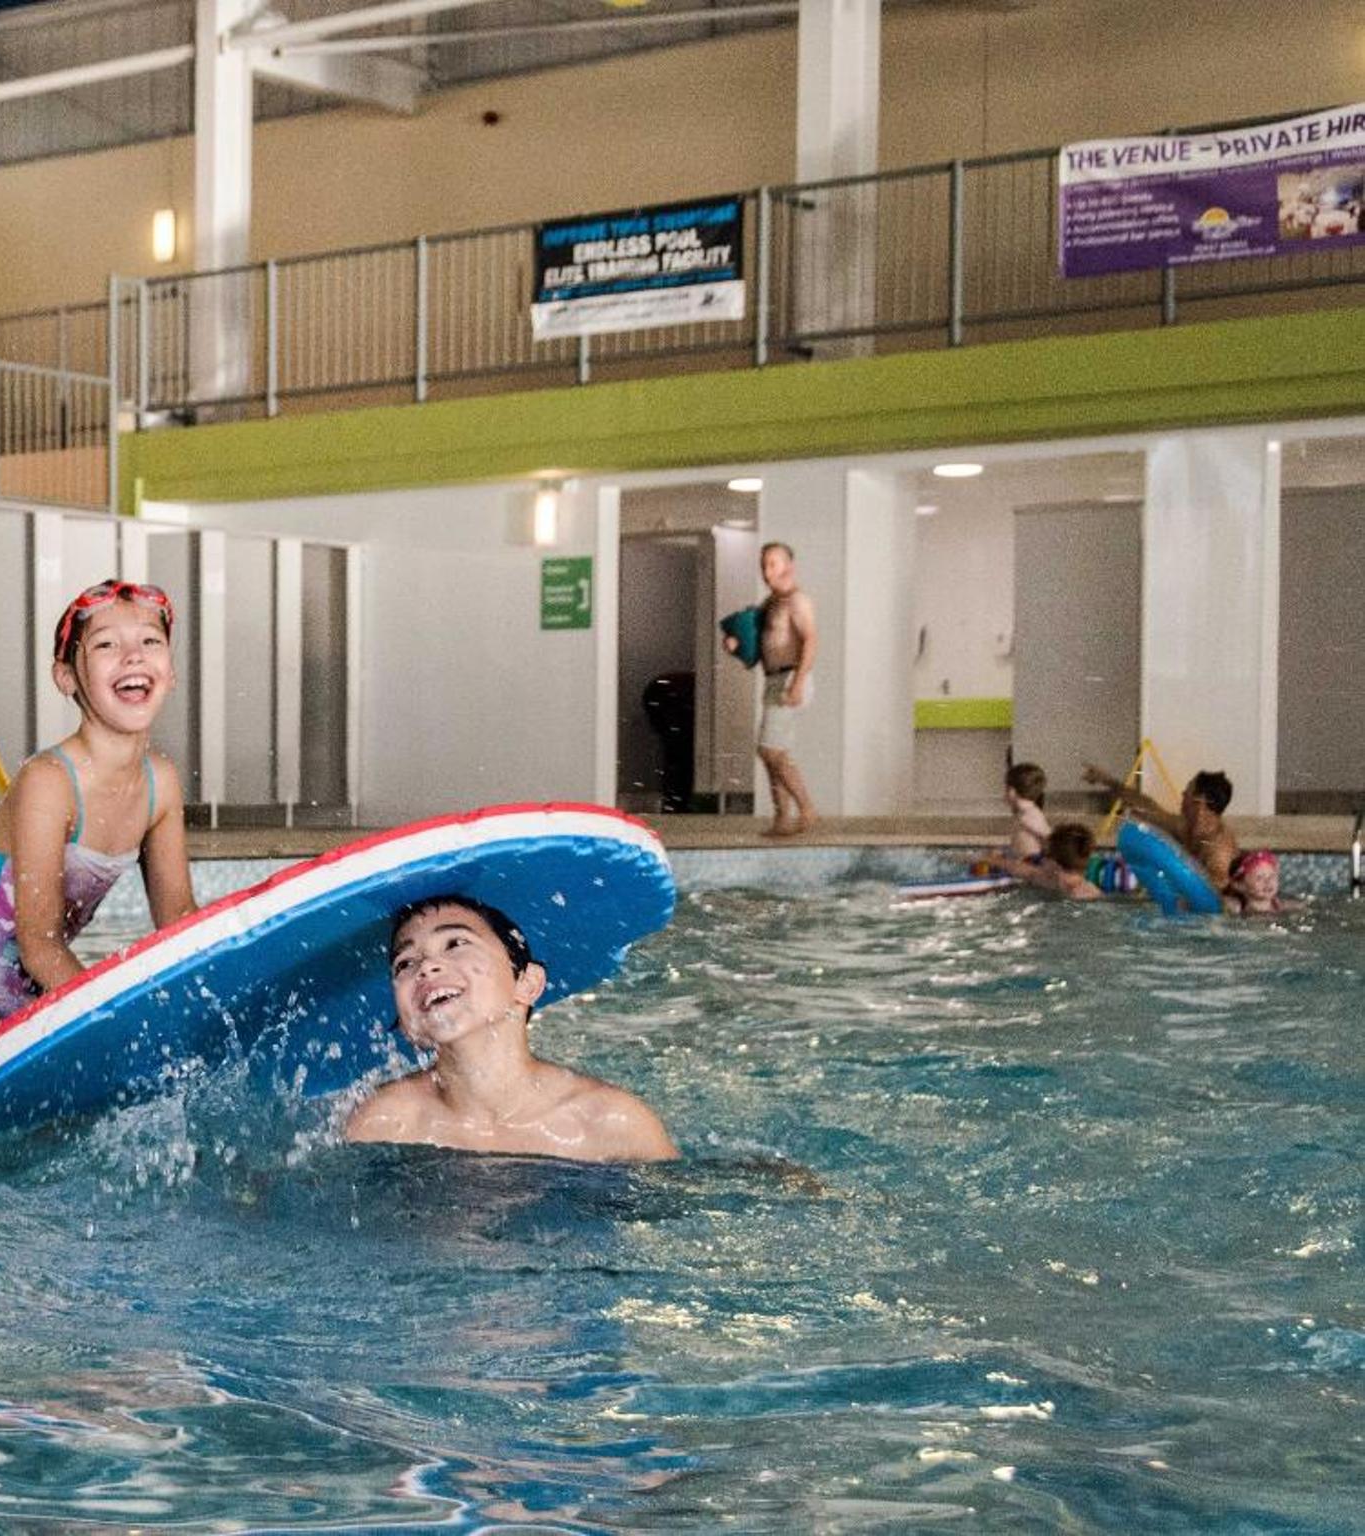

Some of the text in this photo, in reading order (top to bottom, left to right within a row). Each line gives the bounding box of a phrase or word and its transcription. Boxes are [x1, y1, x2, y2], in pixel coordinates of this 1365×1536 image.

[1067, 148, 1107, 170] THE
[1113, 140, 1192, 166] VENUE
[1216, 121, 1321, 157] PRIVATE
[543, 264, 585, 288] ELITE
[587, 254, 660, 281] TRAINING
[662, 245, 732, 273] FACILITY
[572, 227, 702, 265] ENDLESS POOL
